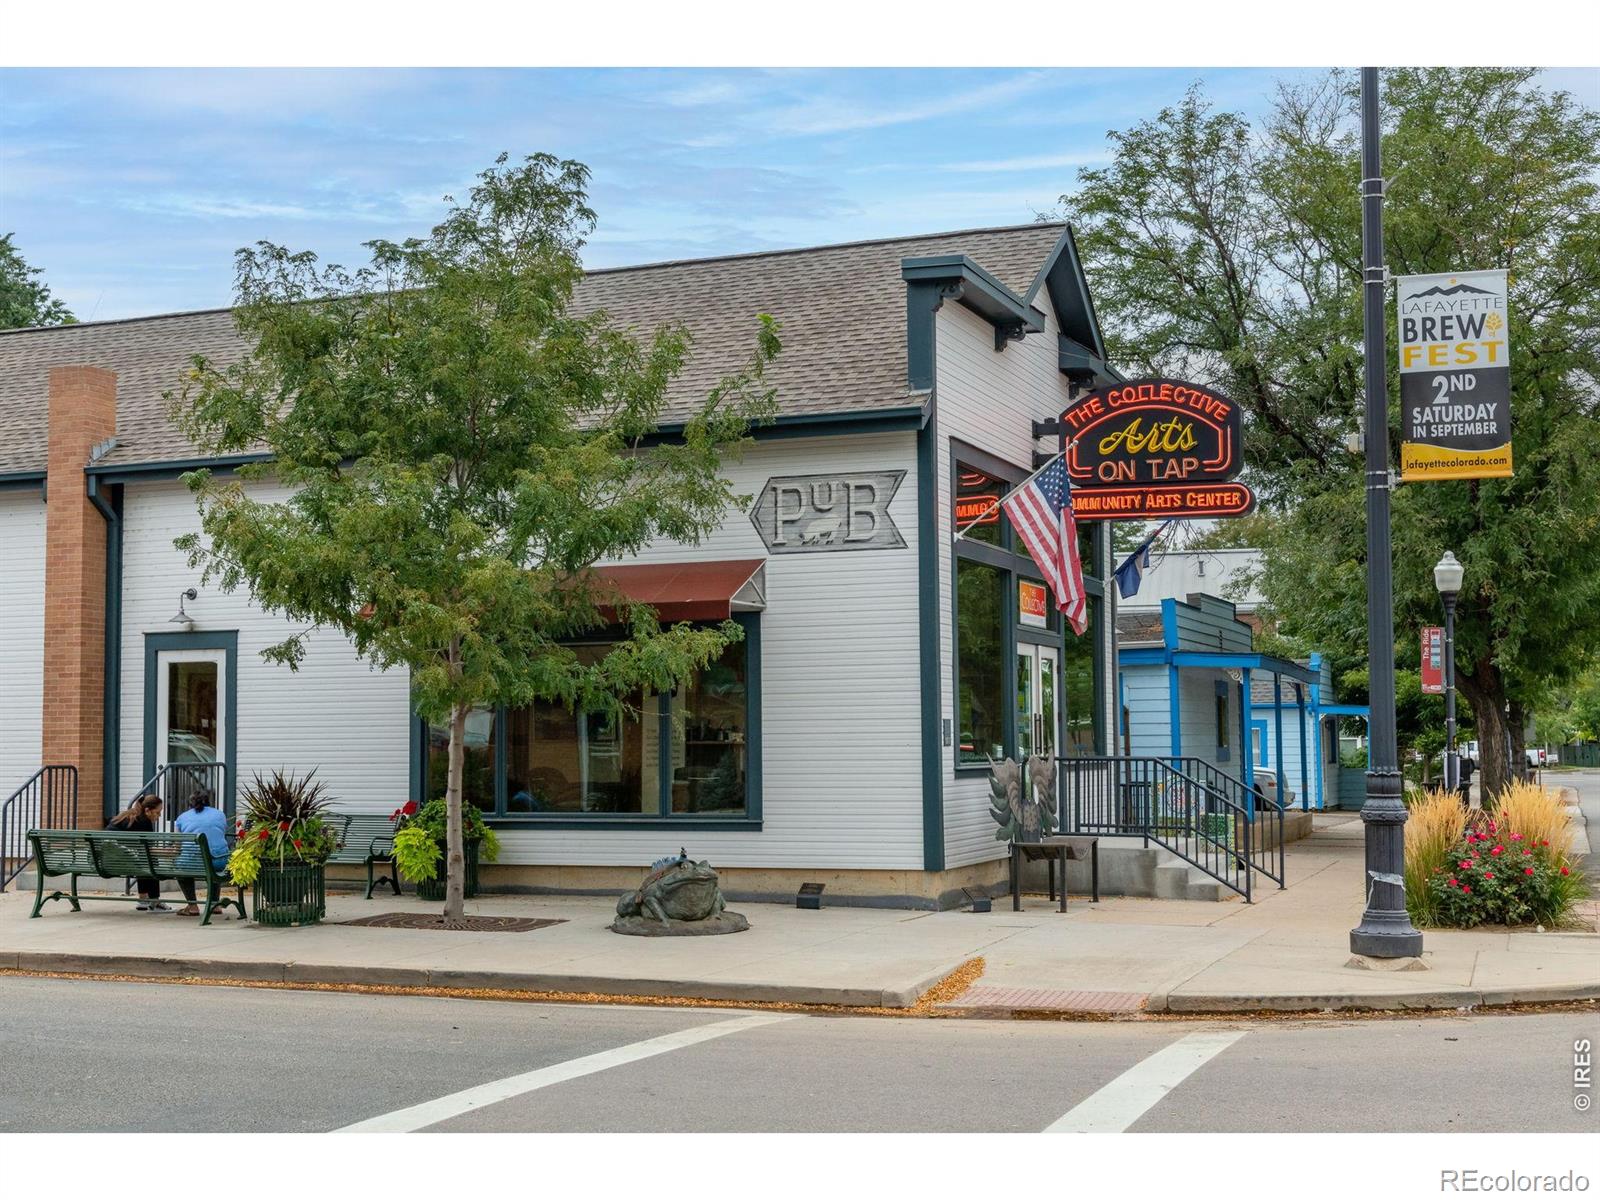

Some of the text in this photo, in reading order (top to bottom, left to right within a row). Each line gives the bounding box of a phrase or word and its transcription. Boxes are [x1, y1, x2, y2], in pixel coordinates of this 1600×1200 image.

[1402, 297, 1504, 315] LAFAYETTE
[1402, 312, 1487, 343] BREW
[1402, 341, 1505, 368] FEST
[1432, 373, 1477, 404] 2ND
[1064, 383, 1232, 428] THE COLLECTIVE
[1412, 402, 1498, 424] SATURDAY
[1098, 415, 1198, 455] Arts
[1412, 421, 1498, 438] IN SEPTEMBER
[1098, 457, 1199, 482] ON TAP
[1406, 456, 1508, 471] lafayettecolorado.com
[1145, 493, 1182, 510] ARTS
[1186, 491, 1241, 507] CENTER
